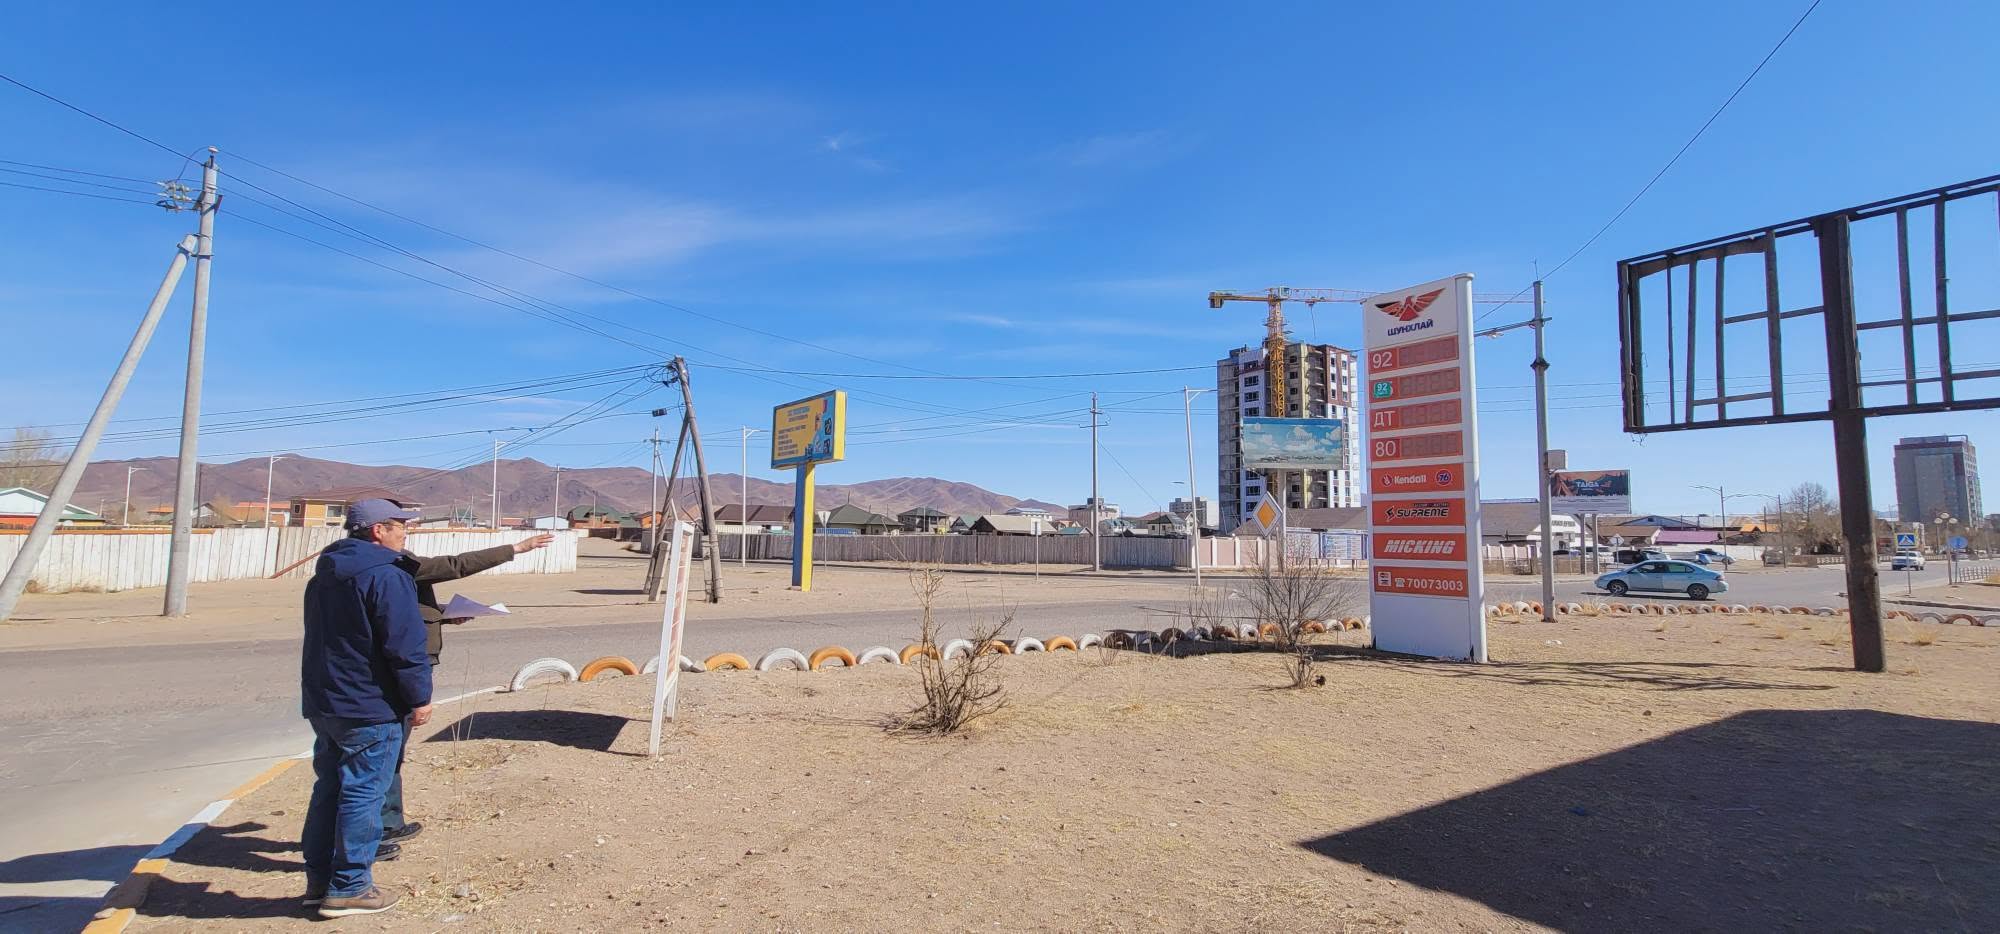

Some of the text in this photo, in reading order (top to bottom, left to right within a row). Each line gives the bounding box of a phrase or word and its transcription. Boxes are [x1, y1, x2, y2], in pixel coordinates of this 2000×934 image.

[1387, 319, 1434, 336] ШУНХЛАЙ
[1372, 352, 1393, 369] 92
[1377, 383, 1388, 392] 92
[1373, 410, 1396, 428] ДТ
[1375, 440, 1396, 457] 80
[1394, 474, 1449, 484] Kendall 76
[1397, 509, 1448, 517] SUPREME
[1385, 540, 1455, 554] MICKING
[1407, 578, 1464, 592] 70073003
